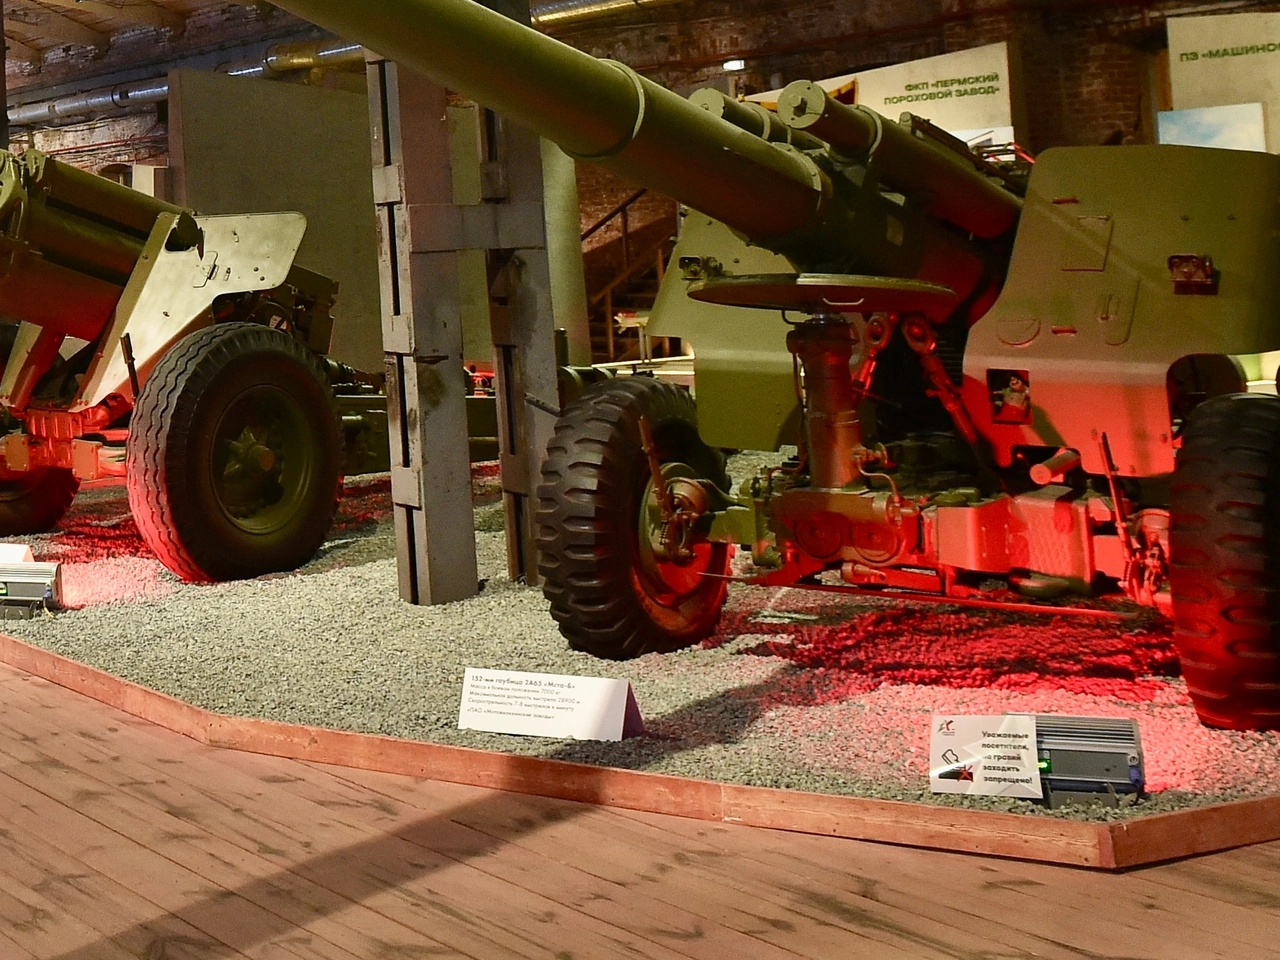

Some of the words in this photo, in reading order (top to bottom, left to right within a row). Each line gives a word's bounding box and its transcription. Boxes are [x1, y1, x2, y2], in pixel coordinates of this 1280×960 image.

[1180, 51, 1199, 62] ПЗ
[1202, 42, 1280, 59] «МАШИНО
[905, 81, 929, 91] ФКП
[931, 71, 1000, 88] «ПЕРМСКИЙ
[884, 89, 953, 105] ПОРОХОВОЙ
[955, 85, 1001, 97] ЗАВОД»
[982, 730, 1029, 739] Уважаемые
[982, 742, 1030, 751] посетители,
[993, 753, 1022, 762] гравий
[983, 765, 1020, 773] заходить
[984, 776, 1033, 784] запрещено!
